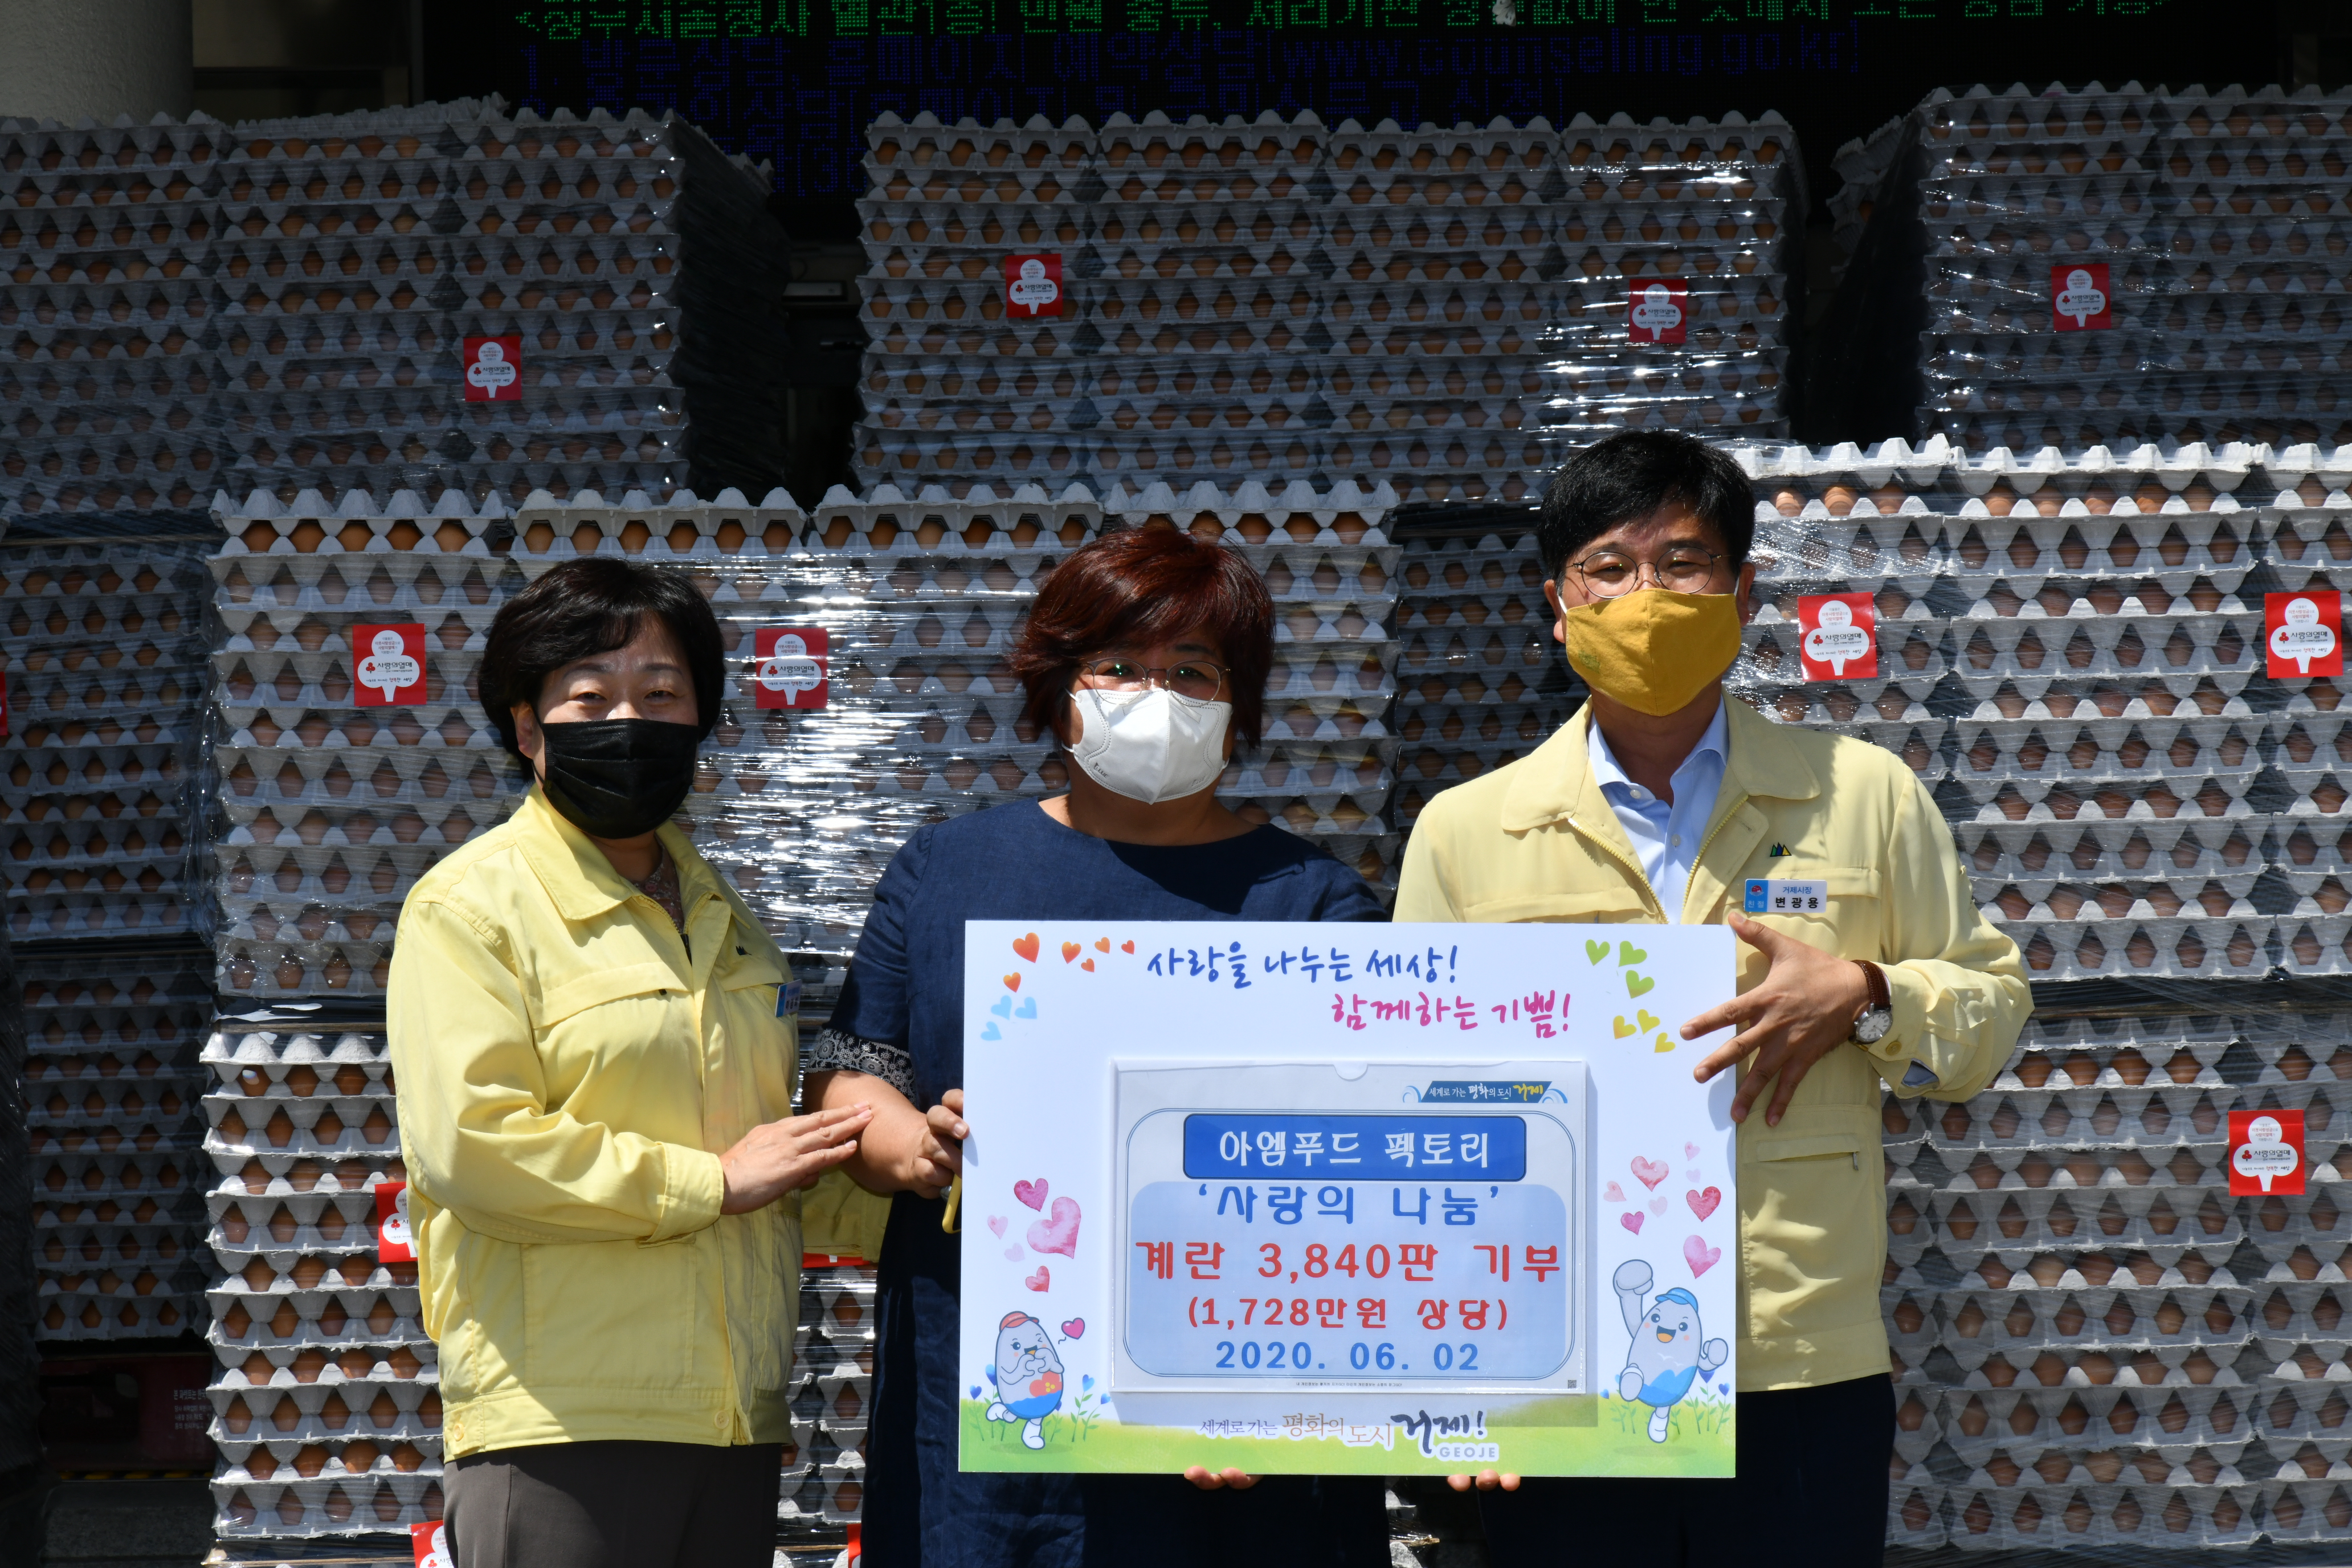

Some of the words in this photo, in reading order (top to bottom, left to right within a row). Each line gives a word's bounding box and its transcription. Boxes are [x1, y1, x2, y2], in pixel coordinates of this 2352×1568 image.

[824, 34, 1026, 85] 홈페이지
[1824, 632, 1862, 643] 사랑의열매
[2290, 631, 2328, 640] 사랑의열매
[377, 662, 413, 670] 사랑의열매
[779, 665, 815, 674] 사랑의열매
[1782, 886, 1812, 895] 거제시장
[1148, 942, 1251, 989] 사랑을
[1264, 946, 1353, 983] 나누는
[1366, 945, 1457, 983] 세상!
[1332, 991, 1477, 1030] 함께하는
[1491, 990, 1570, 1038] 기쁨!
[1429, 1087, 1450, 1097] 세계로
[1452, 1087, 1466, 1097] 가는
[1468, 1083, 1496, 1099] 평화의
[1497, 1087, 1511, 1097] 도시
[1513, 1083, 1544, 1101] 거제
[1220, 1132, 1361, 1166] 아엠푸드
[1385, 1133, 1487, 1167] 펙토리
[2253, 1149, 2290, 1158] 사랑의열매
[1136, 1242, 1225, 1279] 계란
[1258, 1243, 1438, 1284] 3,840판
[1473, 1245, 1560, 1282] 기부
[1189, 1297, 1386, 1330] (1,728만원
[1417, 1300, 1507, 1330] 상당)
[1215, 1341, 1325, 1370] 2020.
[1350, 1343, 1408, 1370] 06.
[1434, 1344, 1477, 1370] 02
[1200, 1419, 1244, 1435] 세계로
[1248, 1420, 1278, 1436] 가는
[1283, 1412, 1344, 1438] 평화의
[1348, 1423, 1391, 1447] 도시
[1390, 1409, 1484, 1454] 거제!
[1439, 1447, 1496, 1458] GEOJE
